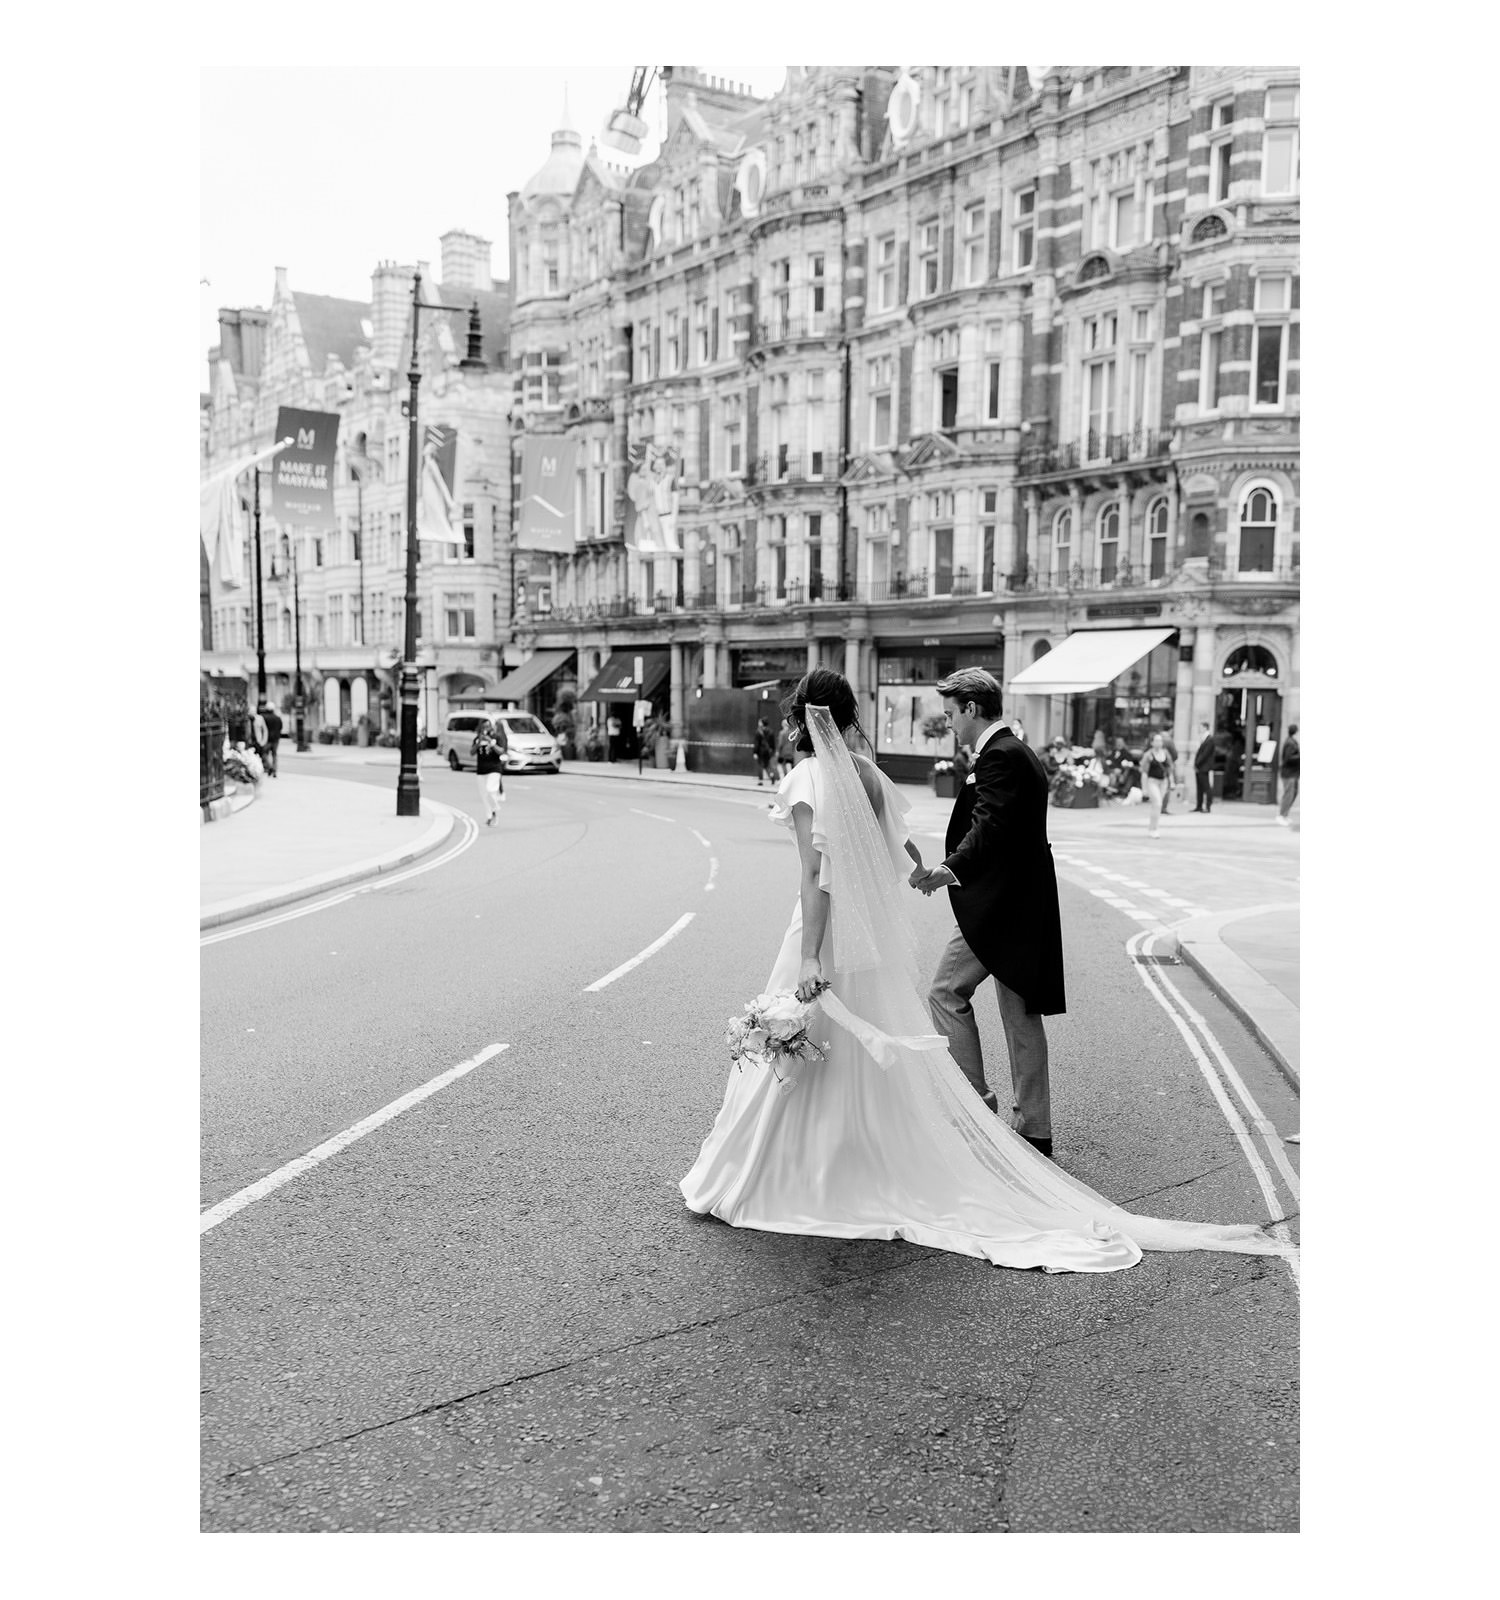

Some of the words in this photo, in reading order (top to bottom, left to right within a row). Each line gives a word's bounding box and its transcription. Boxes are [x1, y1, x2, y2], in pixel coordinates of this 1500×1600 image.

[297, 427, 315, 446] M
[279, 460, 313, 475] MAKE
[315, 463, 328, 477] IT
[541, 456, 556, 472] M
[278, 472, 328, 490] MAYFAIR
